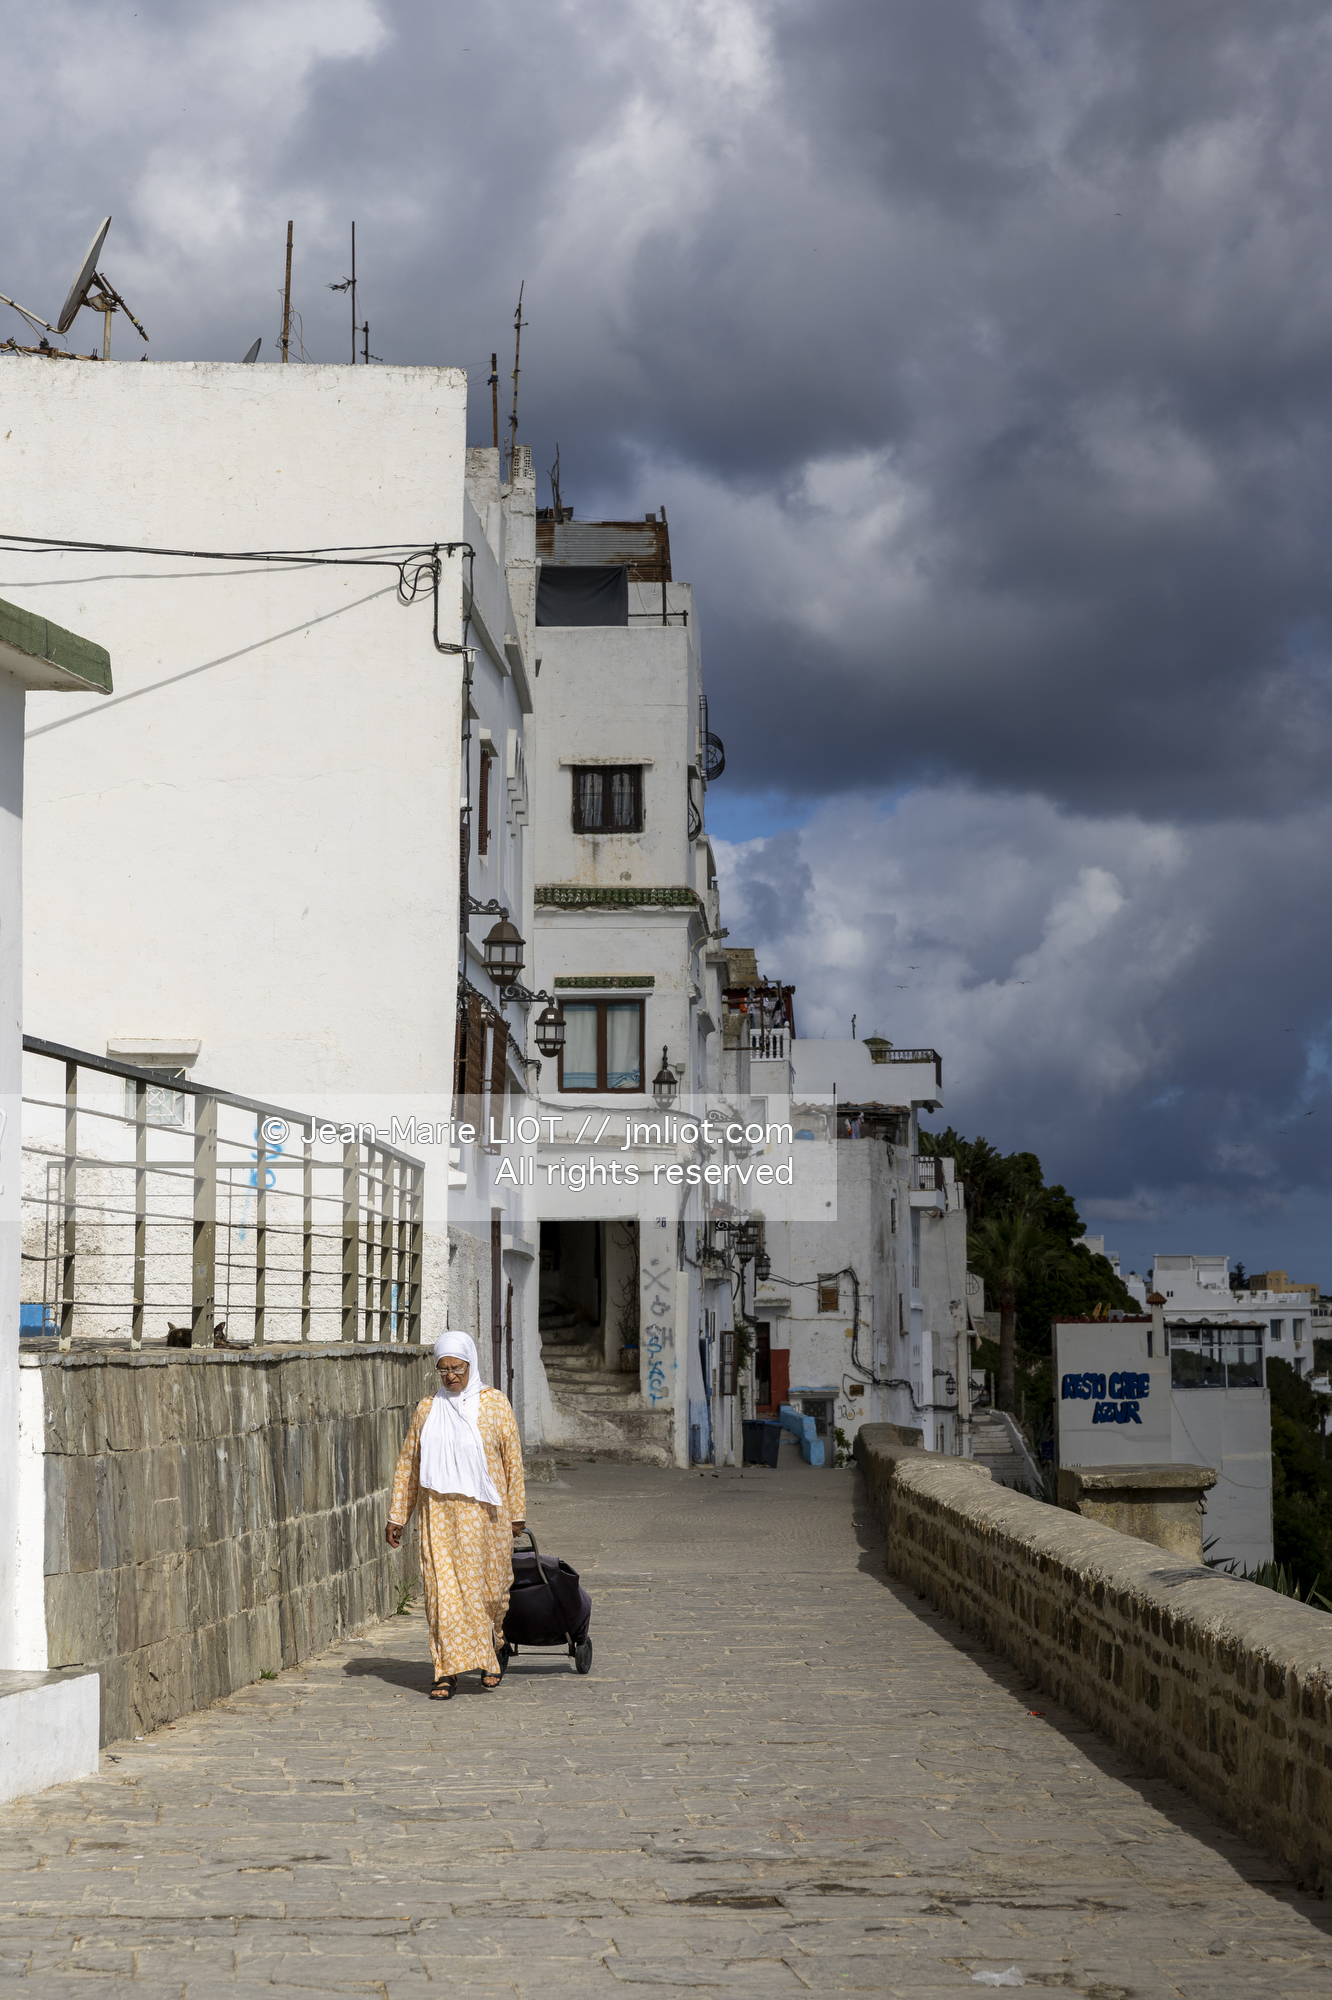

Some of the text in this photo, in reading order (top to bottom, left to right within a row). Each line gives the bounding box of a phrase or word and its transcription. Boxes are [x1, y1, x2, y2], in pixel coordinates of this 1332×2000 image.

[1062, 1371, 1150, 1400] RESTO CAFE
[1092, 1401, 1143, 1424] AZUR
